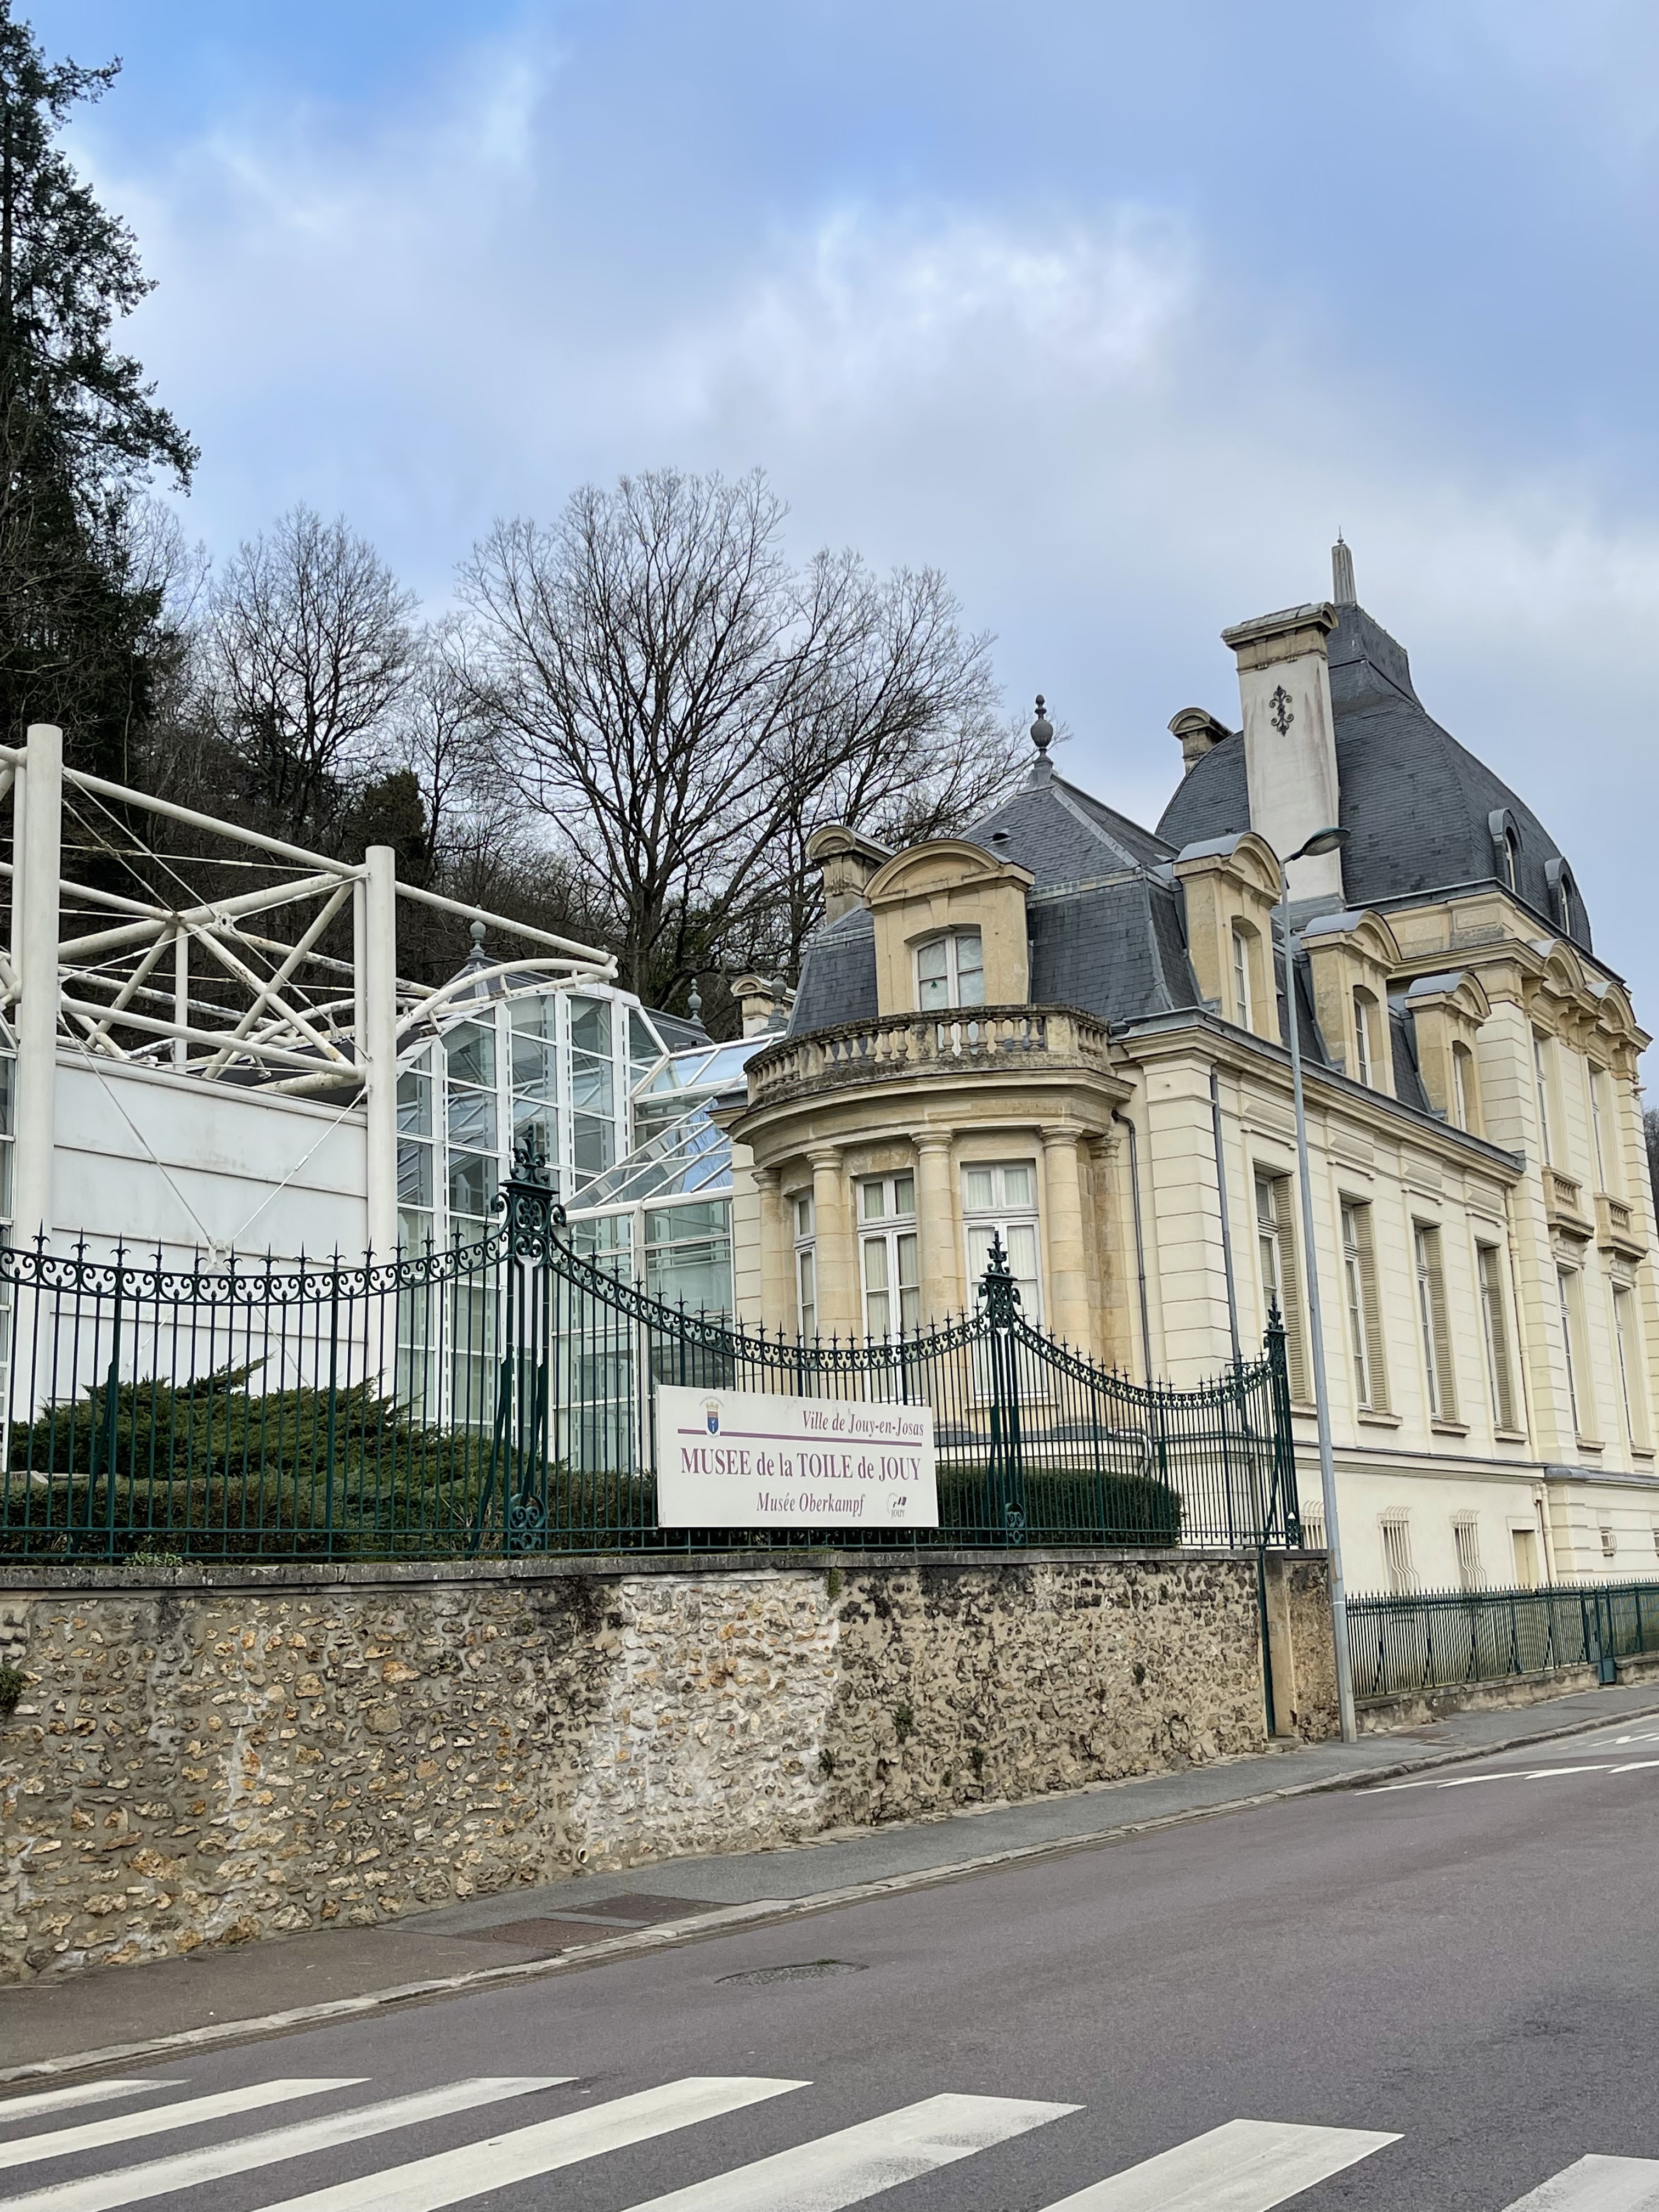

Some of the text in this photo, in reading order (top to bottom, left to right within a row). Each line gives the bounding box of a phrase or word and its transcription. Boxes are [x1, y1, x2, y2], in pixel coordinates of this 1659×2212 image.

[803, 1410, 924, 1437] Ville de Jouy-en-Josas
[680, 1447, 921, 1482] MUSEE de la TOILE de JOUY
[756, 1492, 866, 1517] Musée Oberkampf
